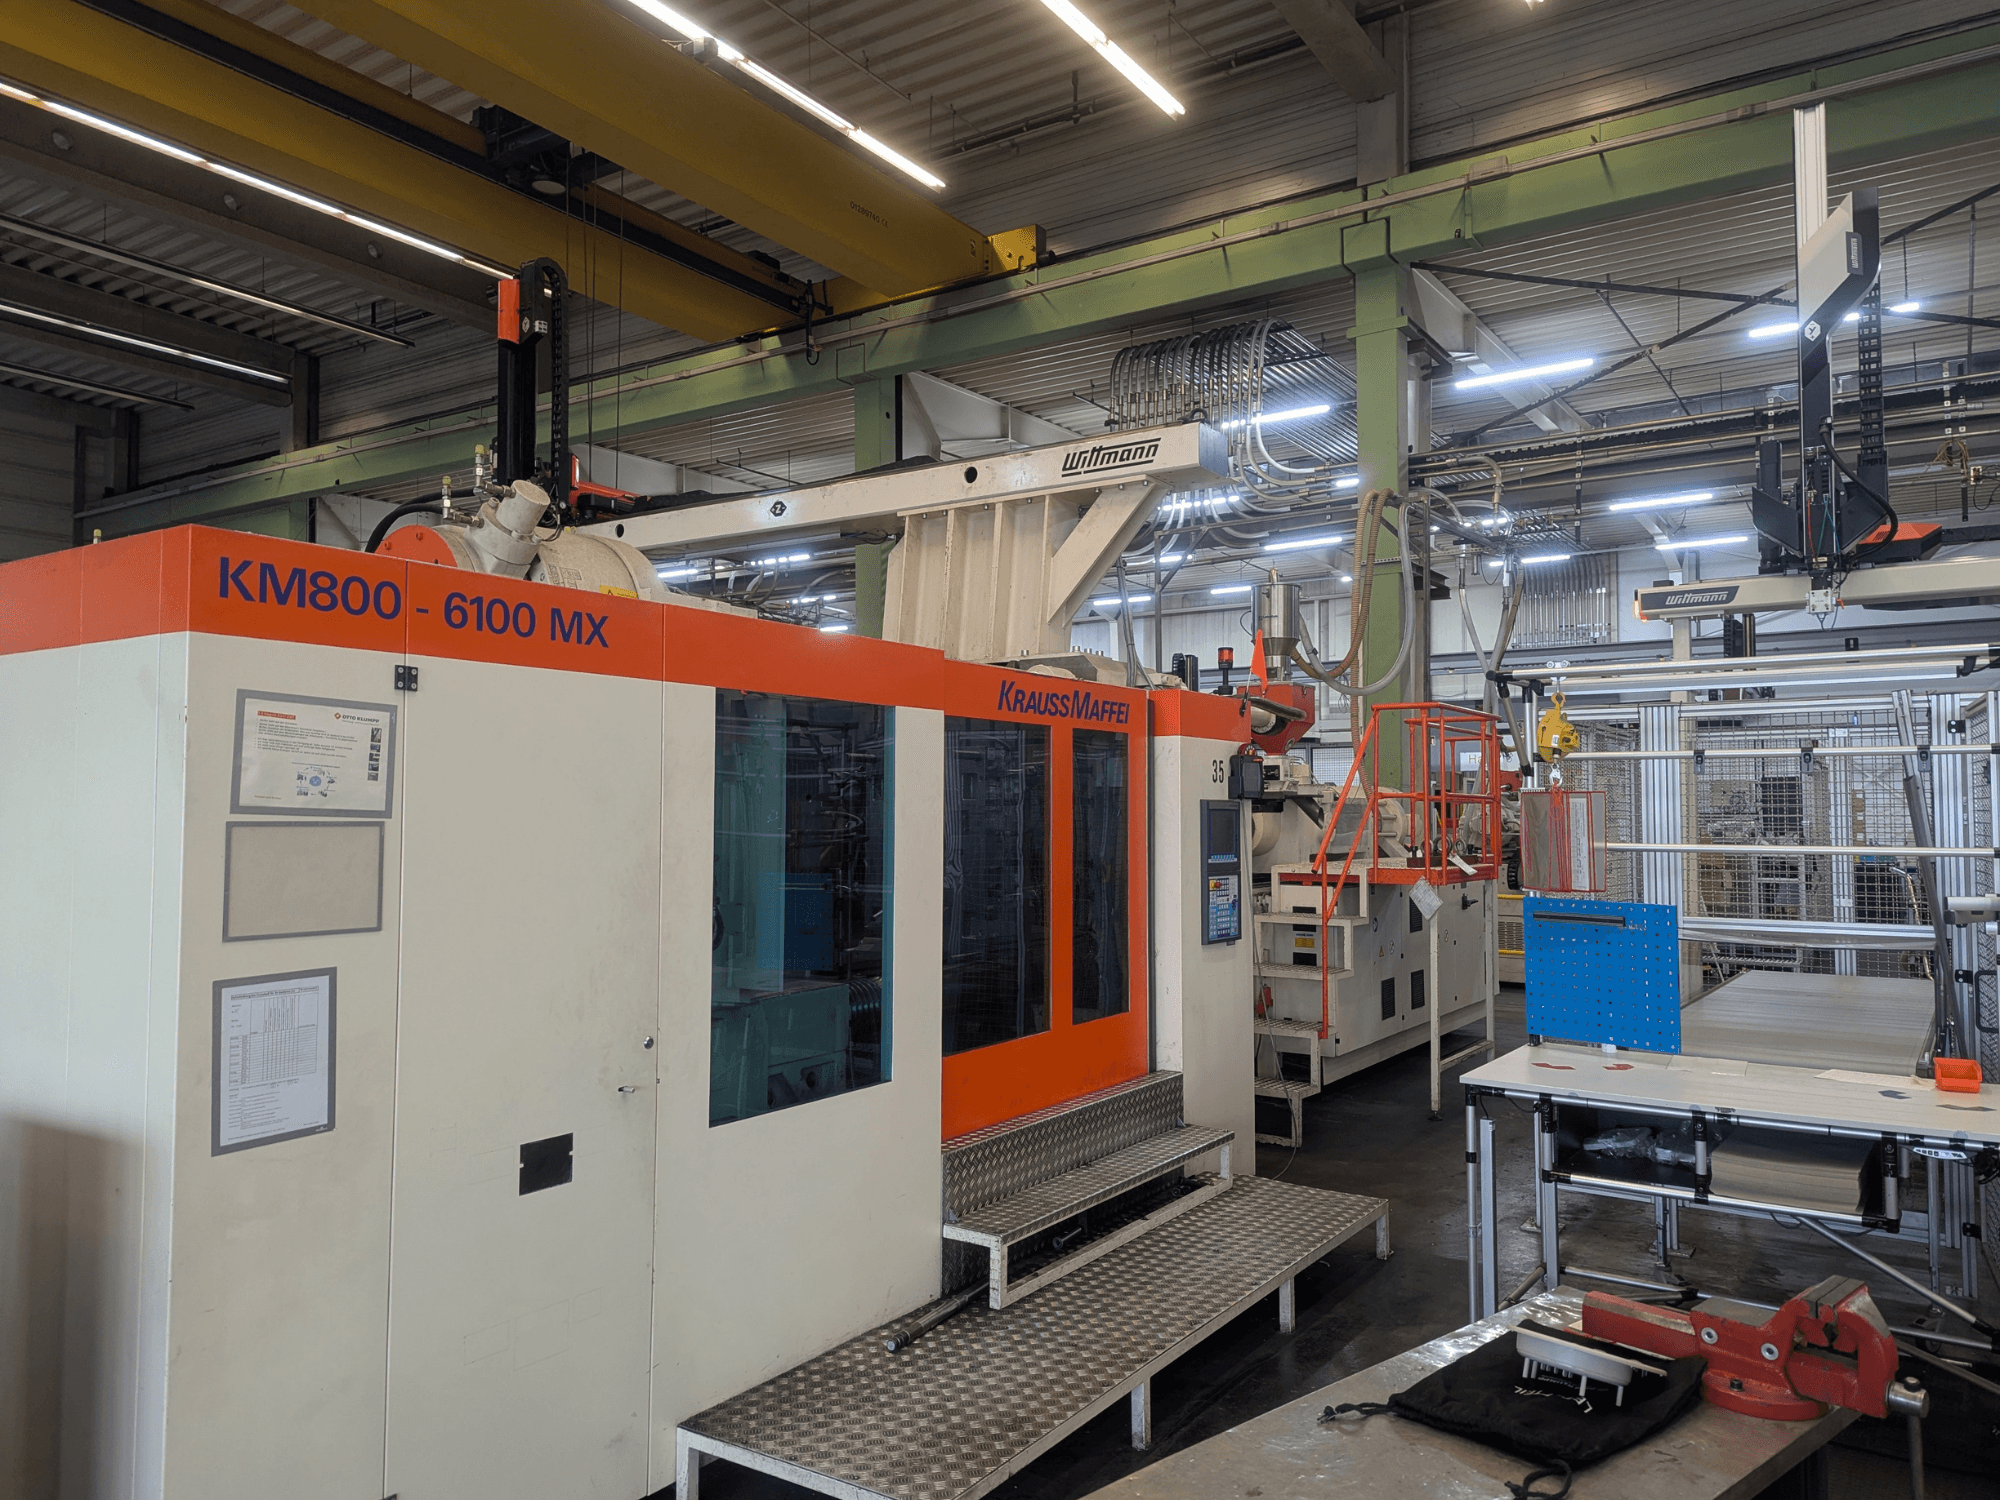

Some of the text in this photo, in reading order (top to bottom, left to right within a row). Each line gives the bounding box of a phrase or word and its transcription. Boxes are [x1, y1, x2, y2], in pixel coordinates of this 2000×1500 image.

[1062, 438, 1161, 472] Wittmann
[219, 556, 402, 620] KM800
[444, 591, 536, 638] 6100
[550, 607, 610, 649] MX
[1665, 591, 1729, 605] Wittmann
[1212, 759, 1224, 783] 35
